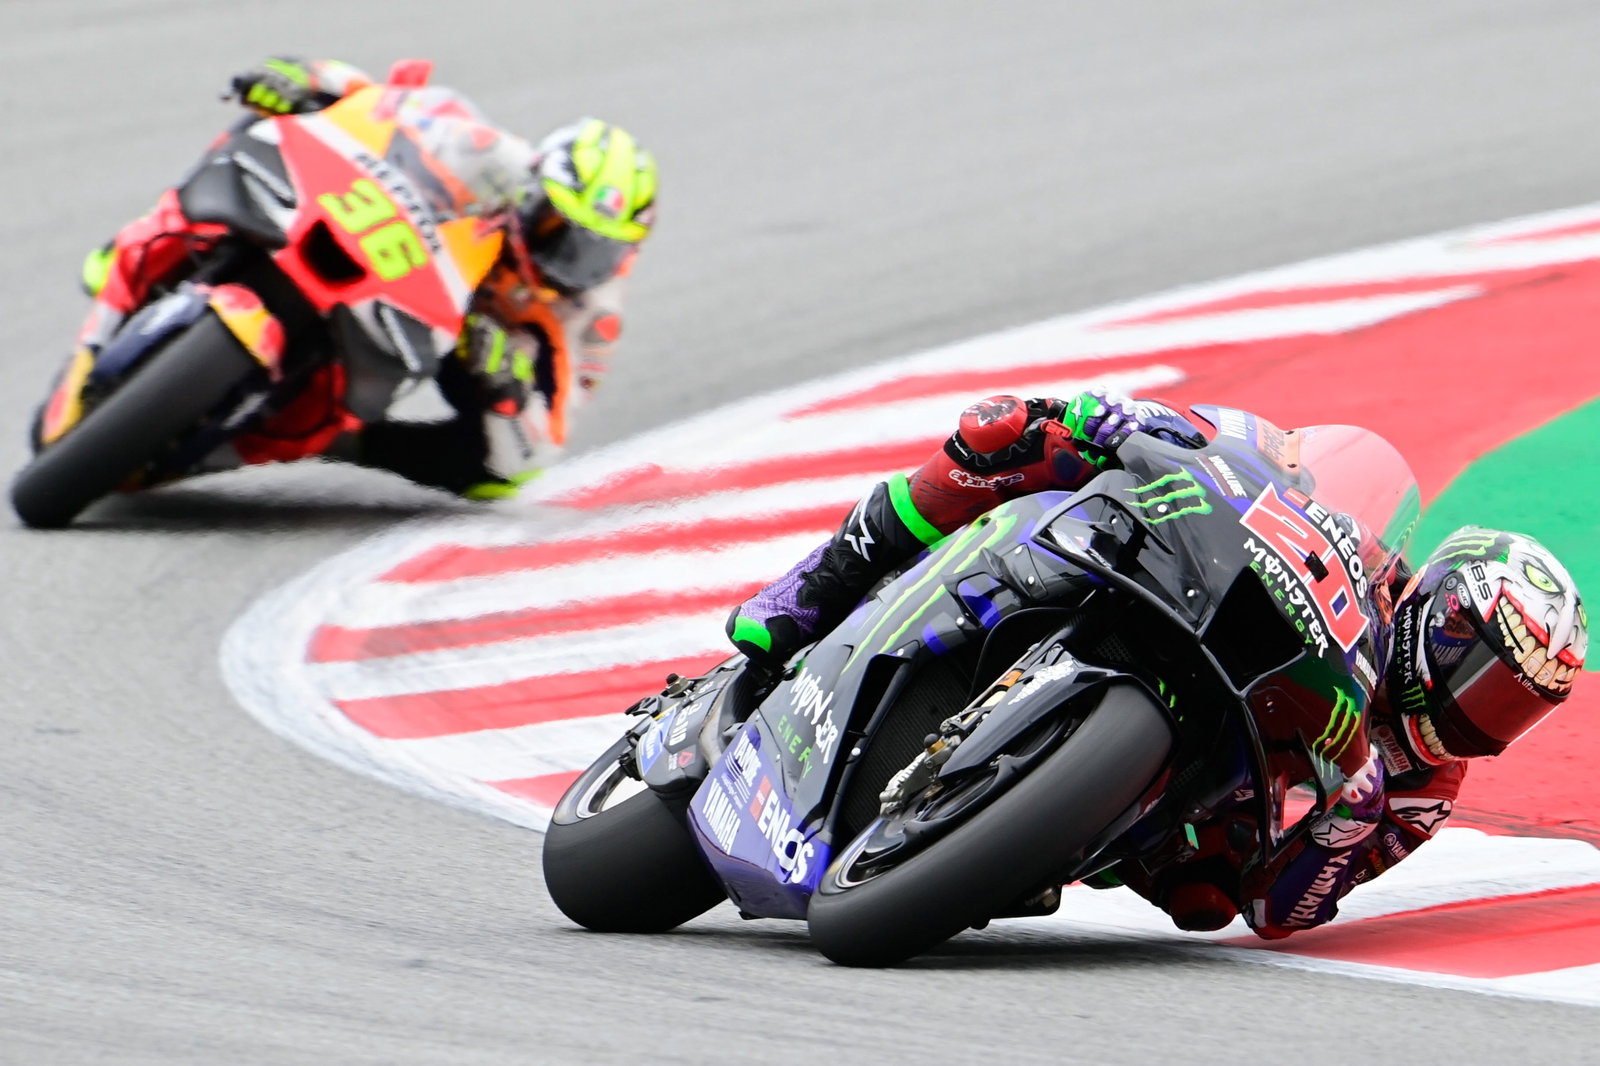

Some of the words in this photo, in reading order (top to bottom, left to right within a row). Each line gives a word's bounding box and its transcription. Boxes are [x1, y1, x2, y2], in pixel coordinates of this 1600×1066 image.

[318, 179, 428, 282] 36
[1239, 481, 1370, 653] 20
[1305, 501, 1368, 599] ENEOS
[1471, 565, 1493, 601] BS
[1243, 538, 1329, 659] MONSTER
[1250, 561, 1313, 644] ENERGY
[1402, 604, 1413, 685] MONSTER
[778, 714, 813, 778] ENERY
[702, 777, 741, 855] YAMAHA
[1281, 850, 1353, 927] YAMAHA
